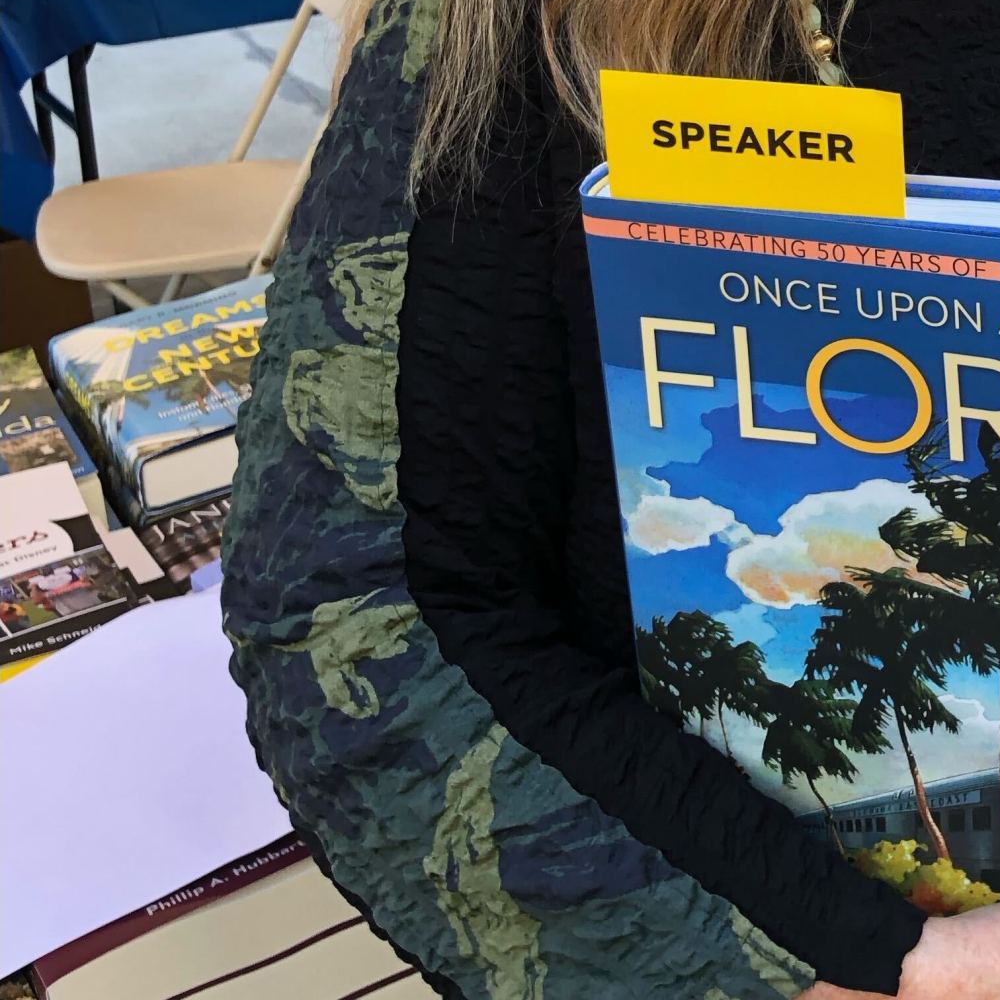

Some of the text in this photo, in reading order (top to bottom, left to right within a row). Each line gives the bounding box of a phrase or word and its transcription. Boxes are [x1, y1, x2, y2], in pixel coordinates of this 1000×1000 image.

[652, 119, 856, 164] SPEAKER
[627, 221, 807, 259] CELEBRATING
[816, 242, 846, 263] 50
[856, 246, 942, 274] YEARS
[951, 258, 988, 279] OF
[104, 294, 267, 354] DREAMS
[719, 271, 841, 315] ONCE
[855, 287, 983, 334] UPON
[123, 339, 261, 393] CENTU
[158, 323, 258, 366] NEW
[152, 499, 232, 544] JAN
[9, 640, 44, 656] Mike
[145, 839, 307, 917] Phillip A. Hubbart
